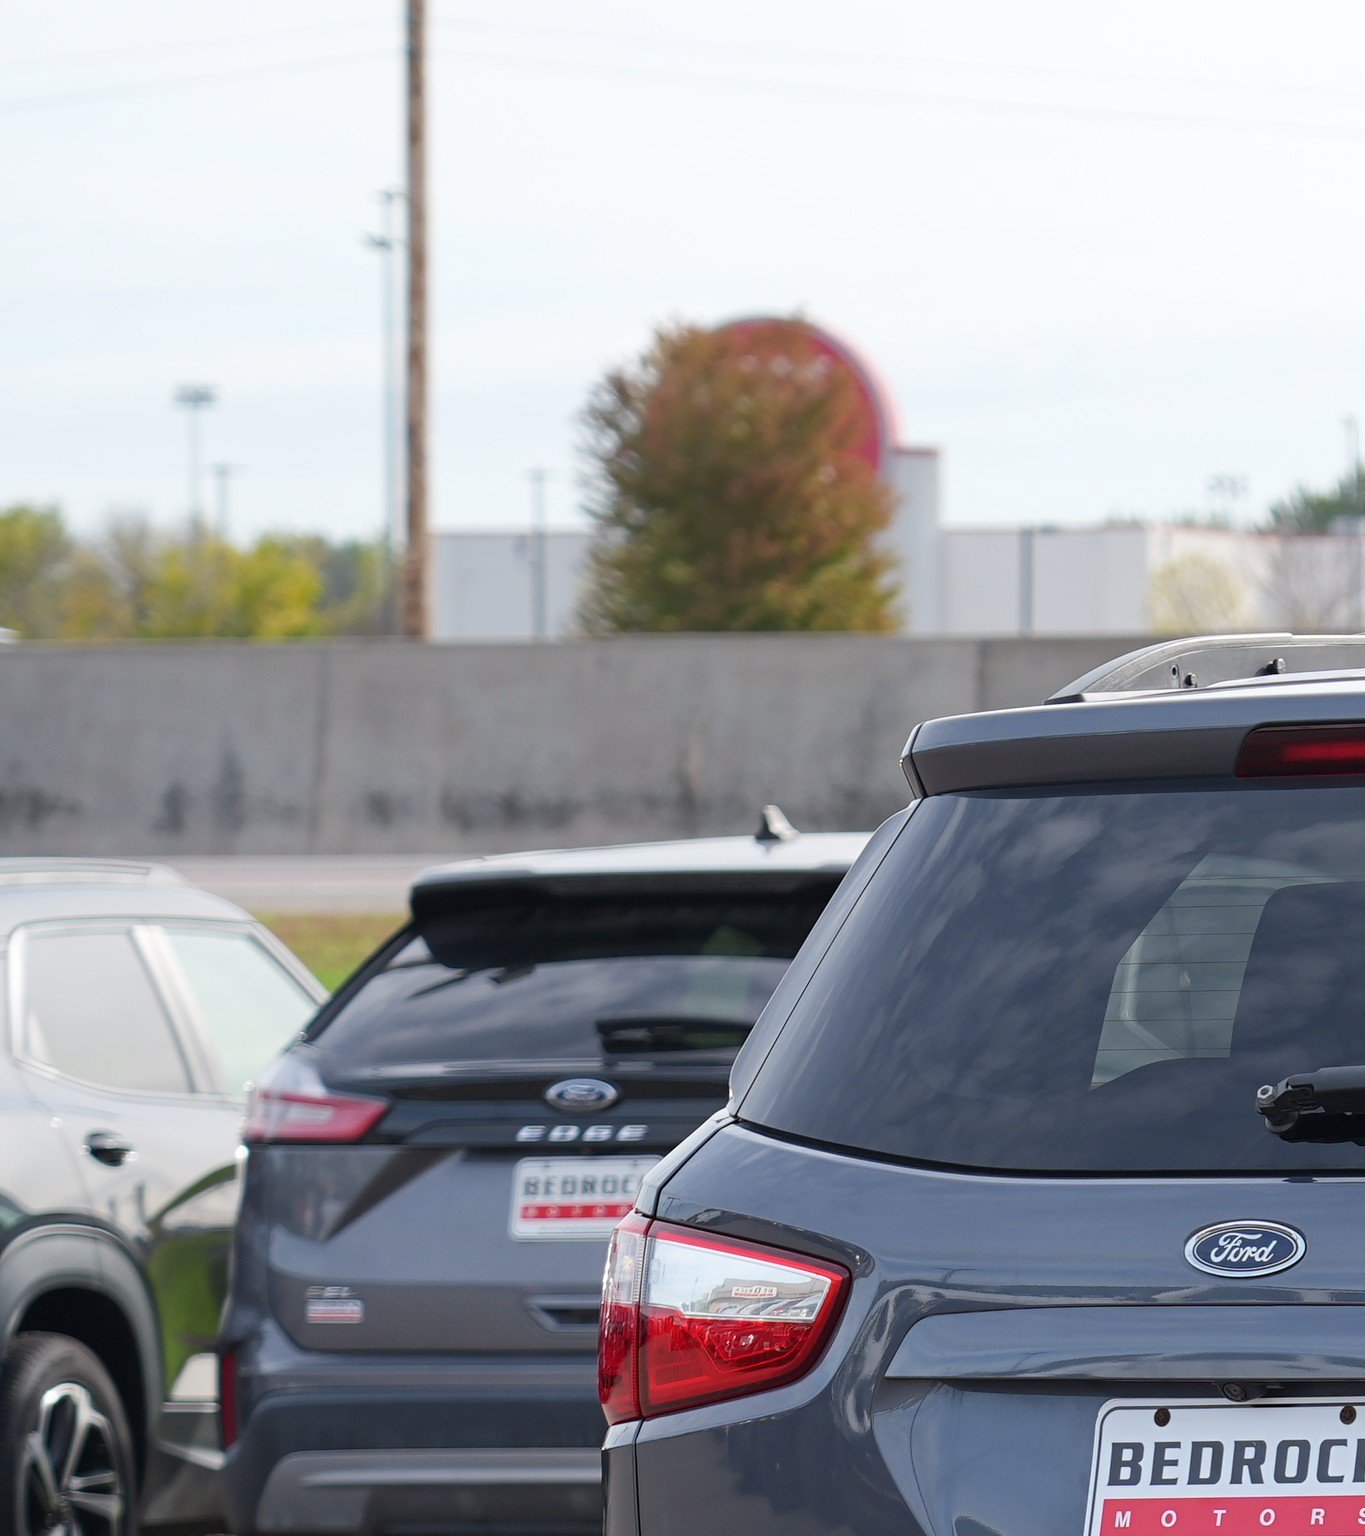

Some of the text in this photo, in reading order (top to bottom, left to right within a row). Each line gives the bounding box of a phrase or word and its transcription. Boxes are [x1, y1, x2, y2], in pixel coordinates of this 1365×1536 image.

[516, 1125, 648, 1142] EDGE
[524, 1174, 637, 1196] BEDROC
[1210, 1232, 1278, 1263] Ford
